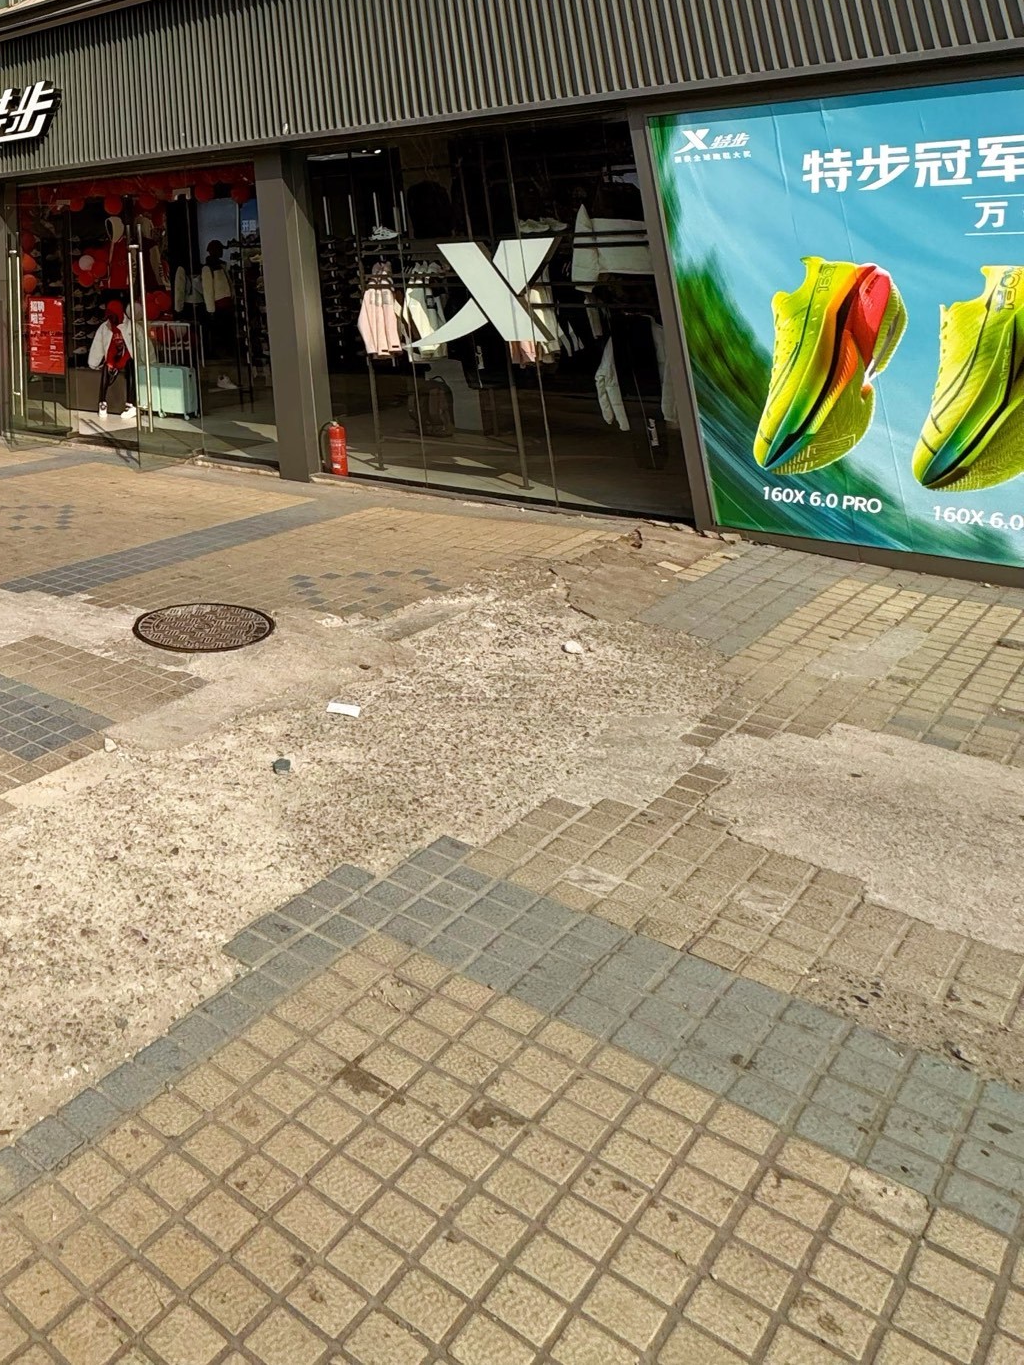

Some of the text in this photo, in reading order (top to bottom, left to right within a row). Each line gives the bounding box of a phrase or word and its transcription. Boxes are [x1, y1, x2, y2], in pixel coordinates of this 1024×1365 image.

[709, 132, 750, 149] 特步
[802, 134, 1024, 194] 特步冠军
[762, 486, 883, 514] 160X 6.0 PRO
[933, 505, 984, 526] 160X
